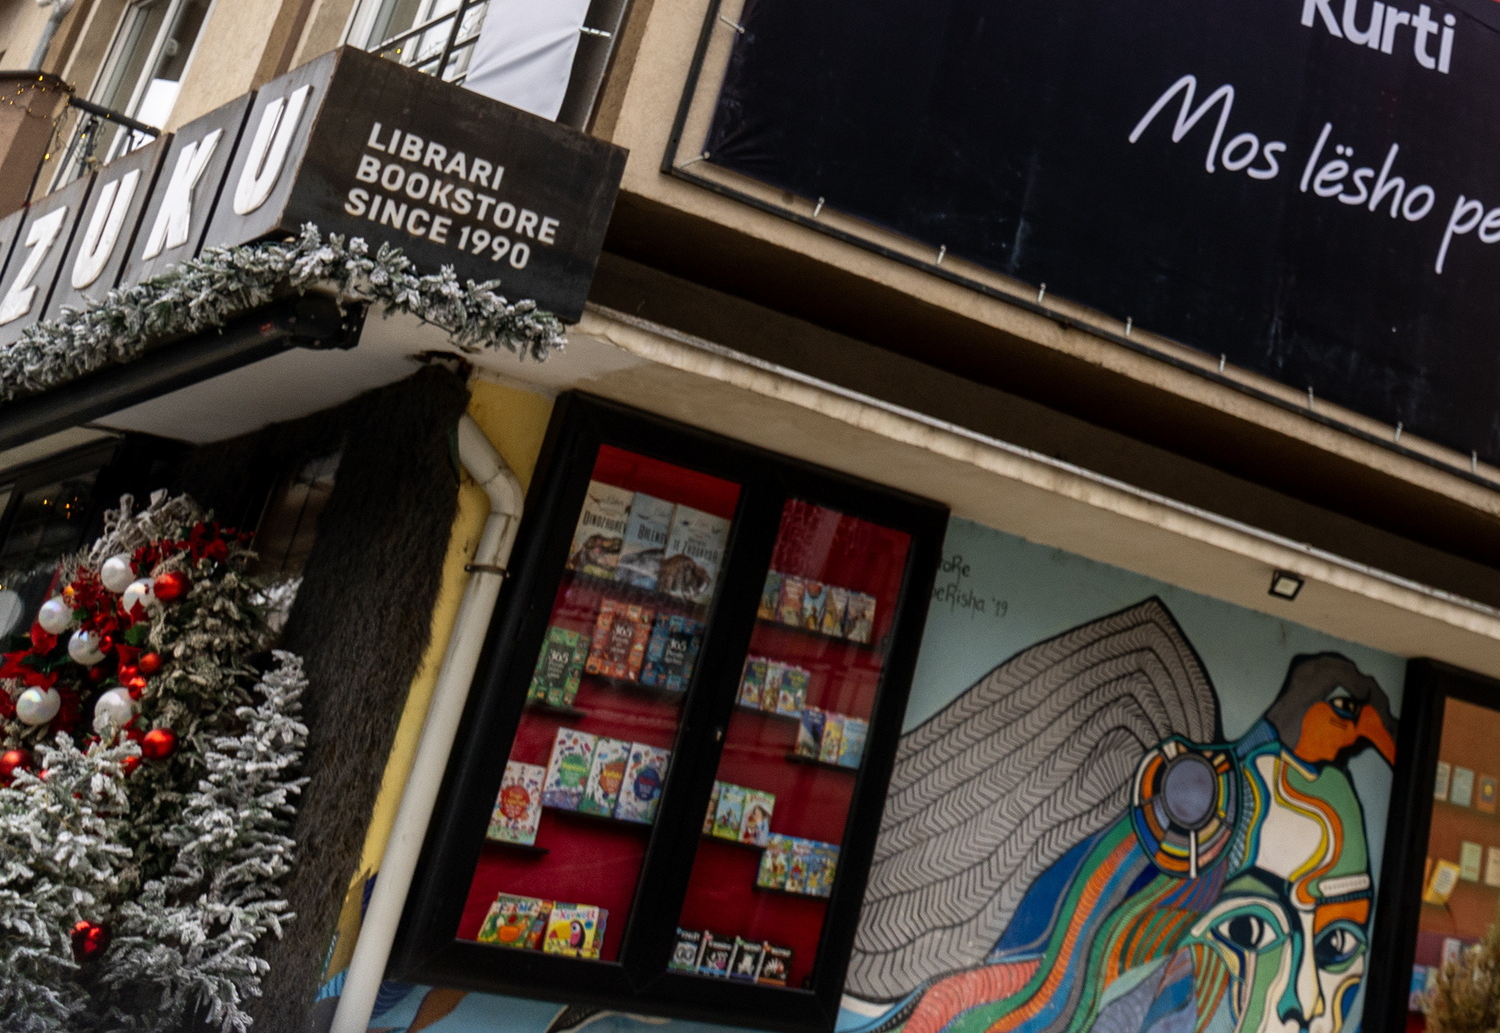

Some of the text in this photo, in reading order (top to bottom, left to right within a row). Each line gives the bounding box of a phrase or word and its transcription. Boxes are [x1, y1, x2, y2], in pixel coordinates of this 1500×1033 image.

[367, 121, 505, 191] LIBRARI
[1128, 74, 1286, 180] Mos
[1299, 122, 1436, 221] lësho
[344, 188, 530, 269] SINCE 1990
[356, 154, 560, 245] BOOKSTORE
